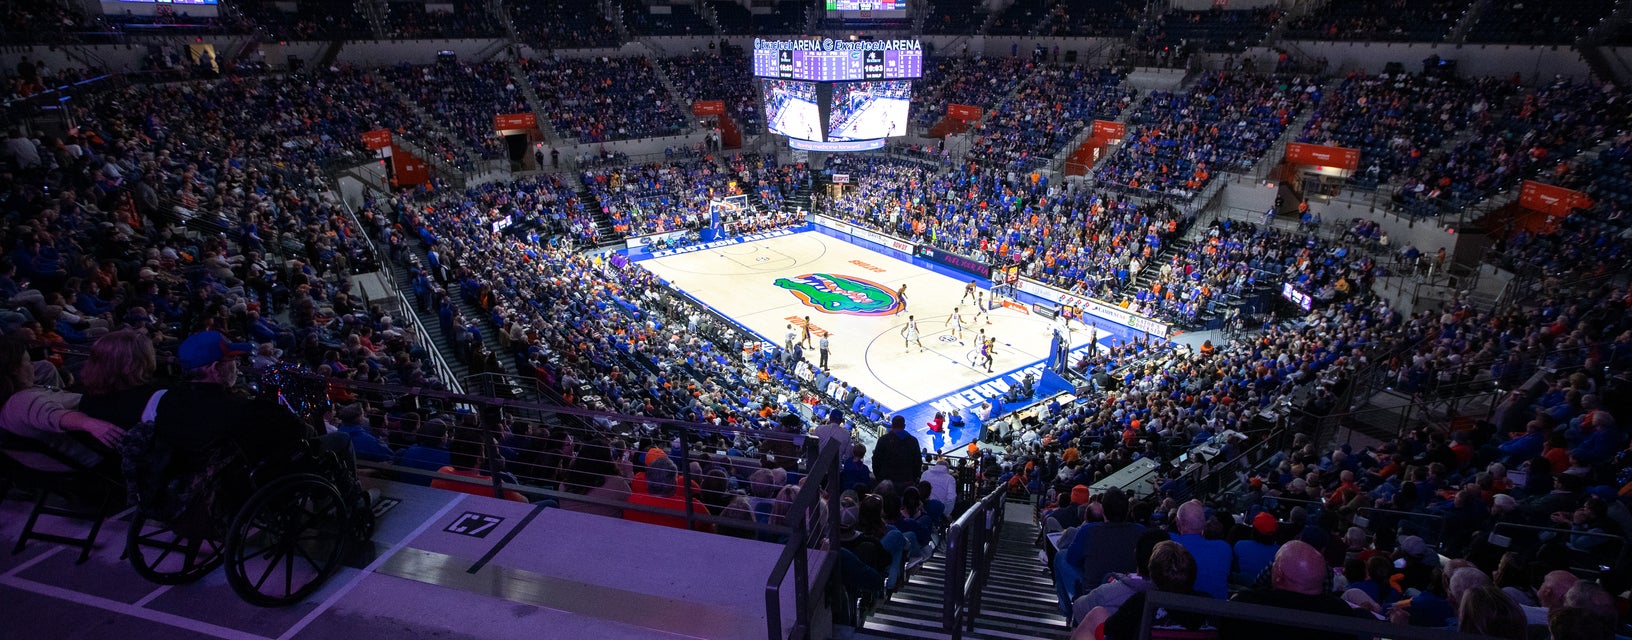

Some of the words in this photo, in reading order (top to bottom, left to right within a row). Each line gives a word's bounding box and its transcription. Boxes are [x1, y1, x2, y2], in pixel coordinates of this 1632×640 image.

[793, 40, 821, 50] ARENA
[834, 39, 885, 51] Exactech
[885, 40, 921, 50] ARENA
[929, 377, 1010, 411] ARENA
[447, 512, 501, 535] C7
